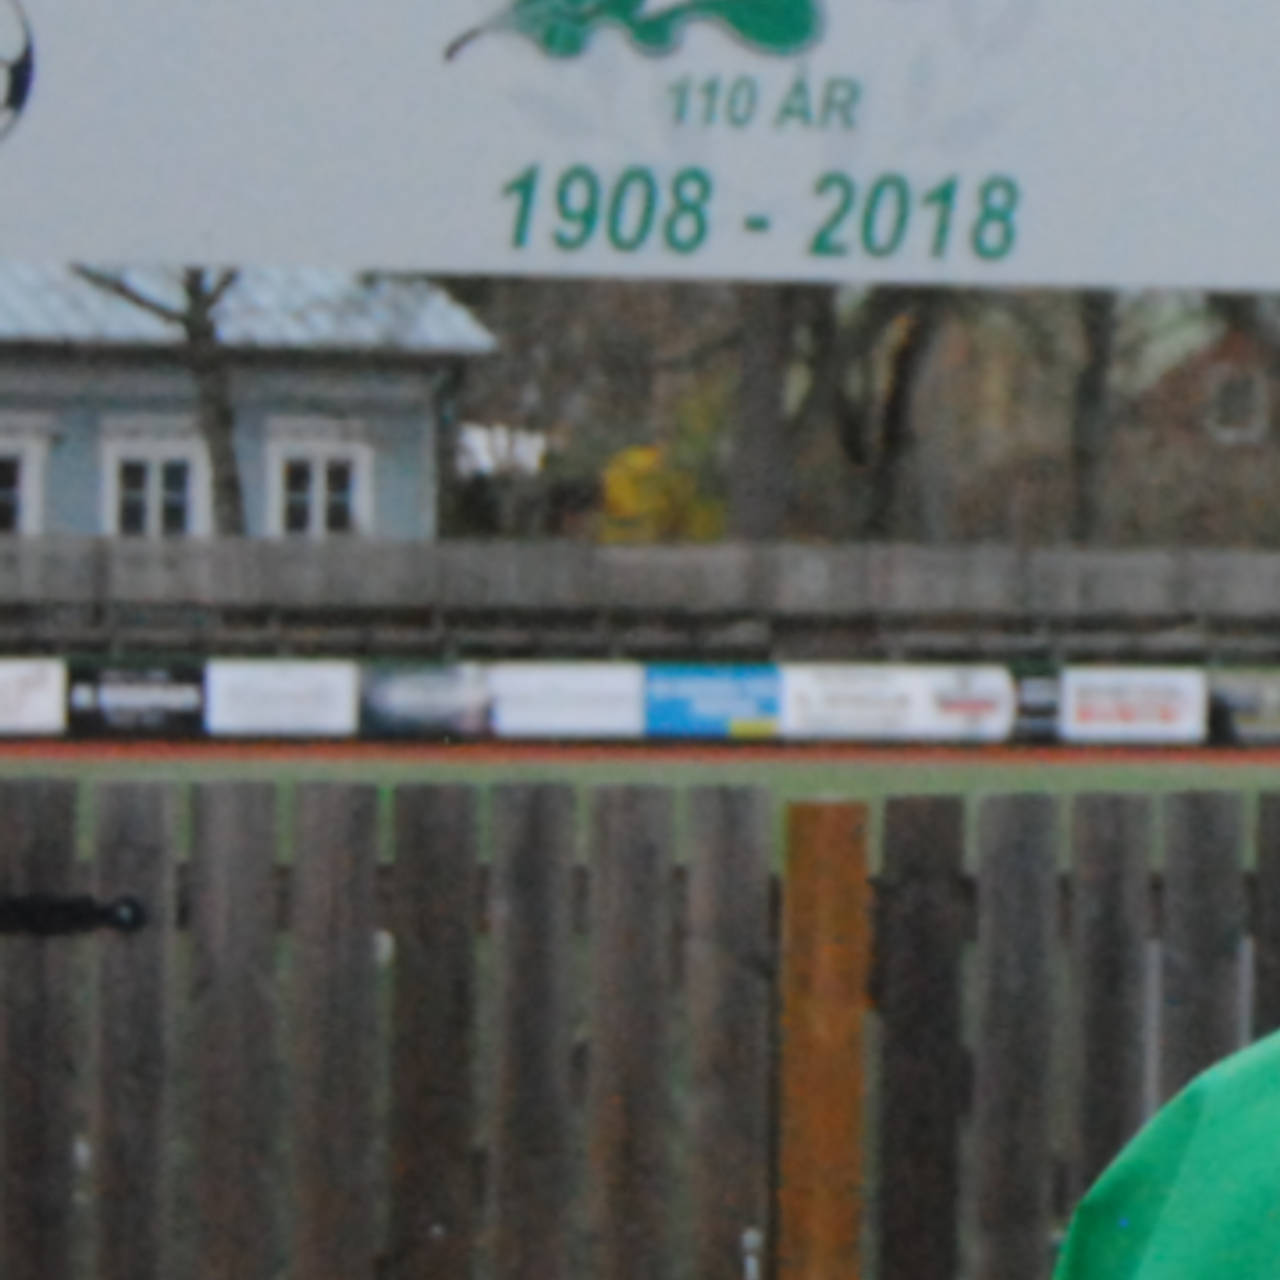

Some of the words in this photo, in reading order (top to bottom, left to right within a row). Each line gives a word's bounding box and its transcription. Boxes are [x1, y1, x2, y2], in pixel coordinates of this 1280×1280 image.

[668, 72, 758, 128] 110
[501, 164, 713, 254] 1908
[743, 213, 770, 234] -
[807, 170, 1021, 261] 2018
